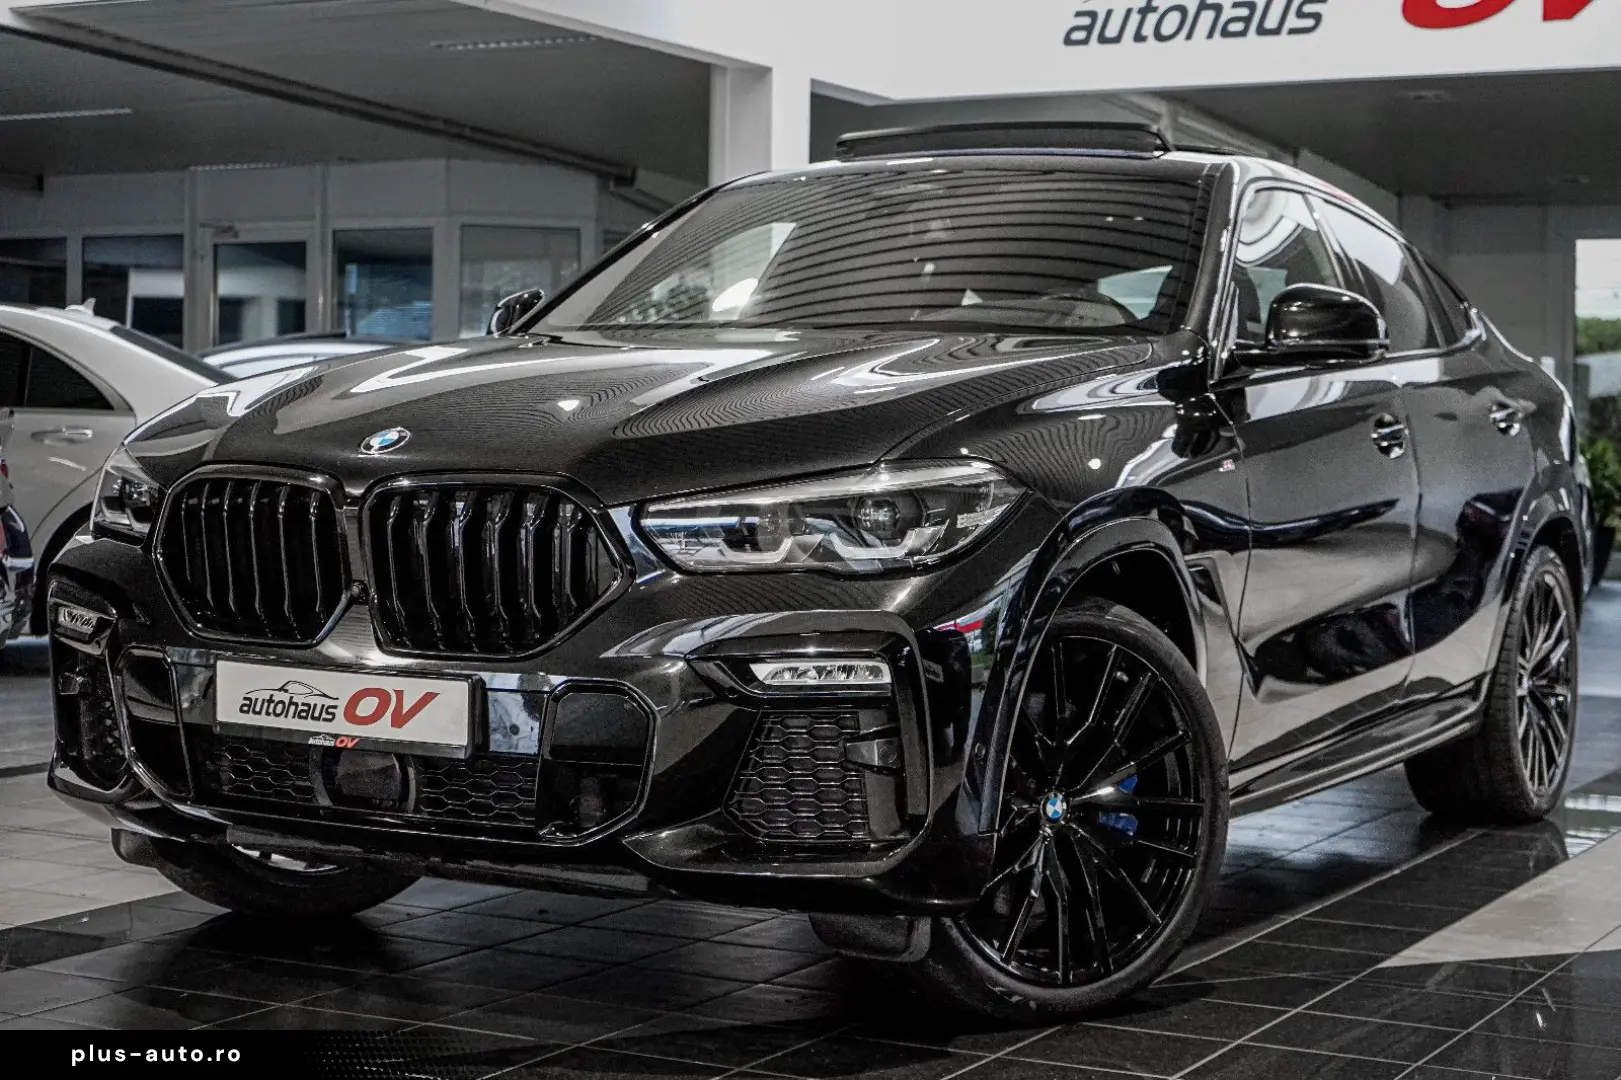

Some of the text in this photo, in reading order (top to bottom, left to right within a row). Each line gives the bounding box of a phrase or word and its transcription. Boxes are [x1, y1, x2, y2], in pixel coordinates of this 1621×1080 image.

[1063, 0, 1328, 46] autohaus
[238, 687, 440, 729] autohaus OV
[336, 736, 360, 748] OV
